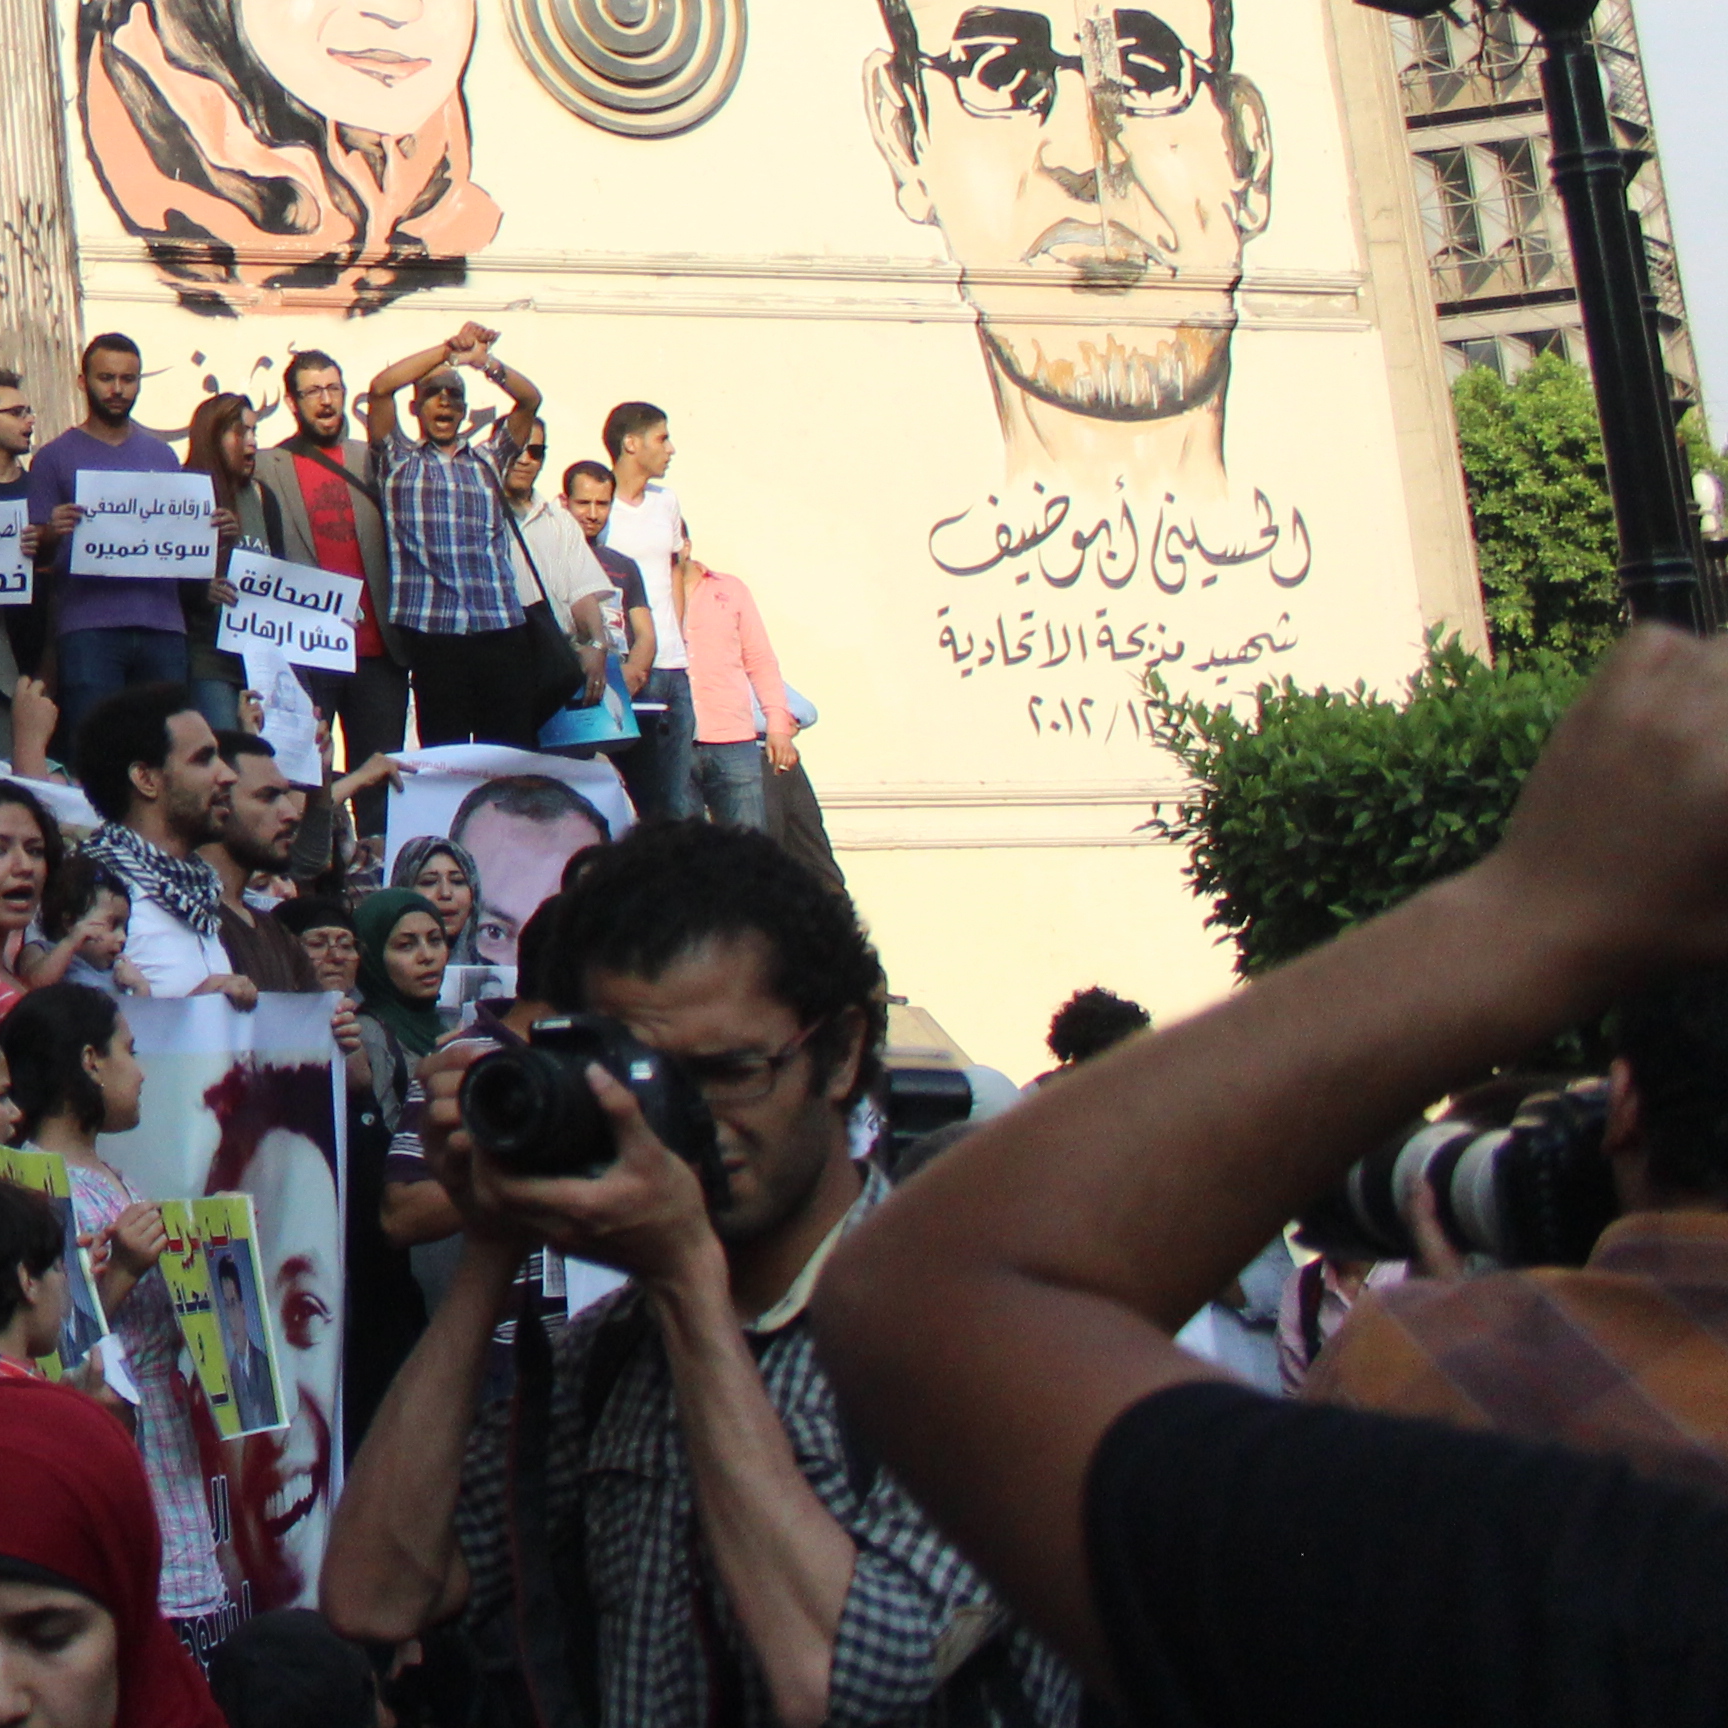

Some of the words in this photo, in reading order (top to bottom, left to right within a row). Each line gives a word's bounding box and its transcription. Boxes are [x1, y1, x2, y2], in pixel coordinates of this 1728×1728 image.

[83, 497, 137, 523] الصحفي
[168, 497, 201, 519] رقابة
[84, 538, 149, 561] ضميره
[154, 539, 211, 561] سوي
[238, 568, 344, 616] الصحافة
[224, 612, 294, 647] ارهاب
[298, 625, 349, 653] مش
[1191, 610, 1299, 686] شهيد
